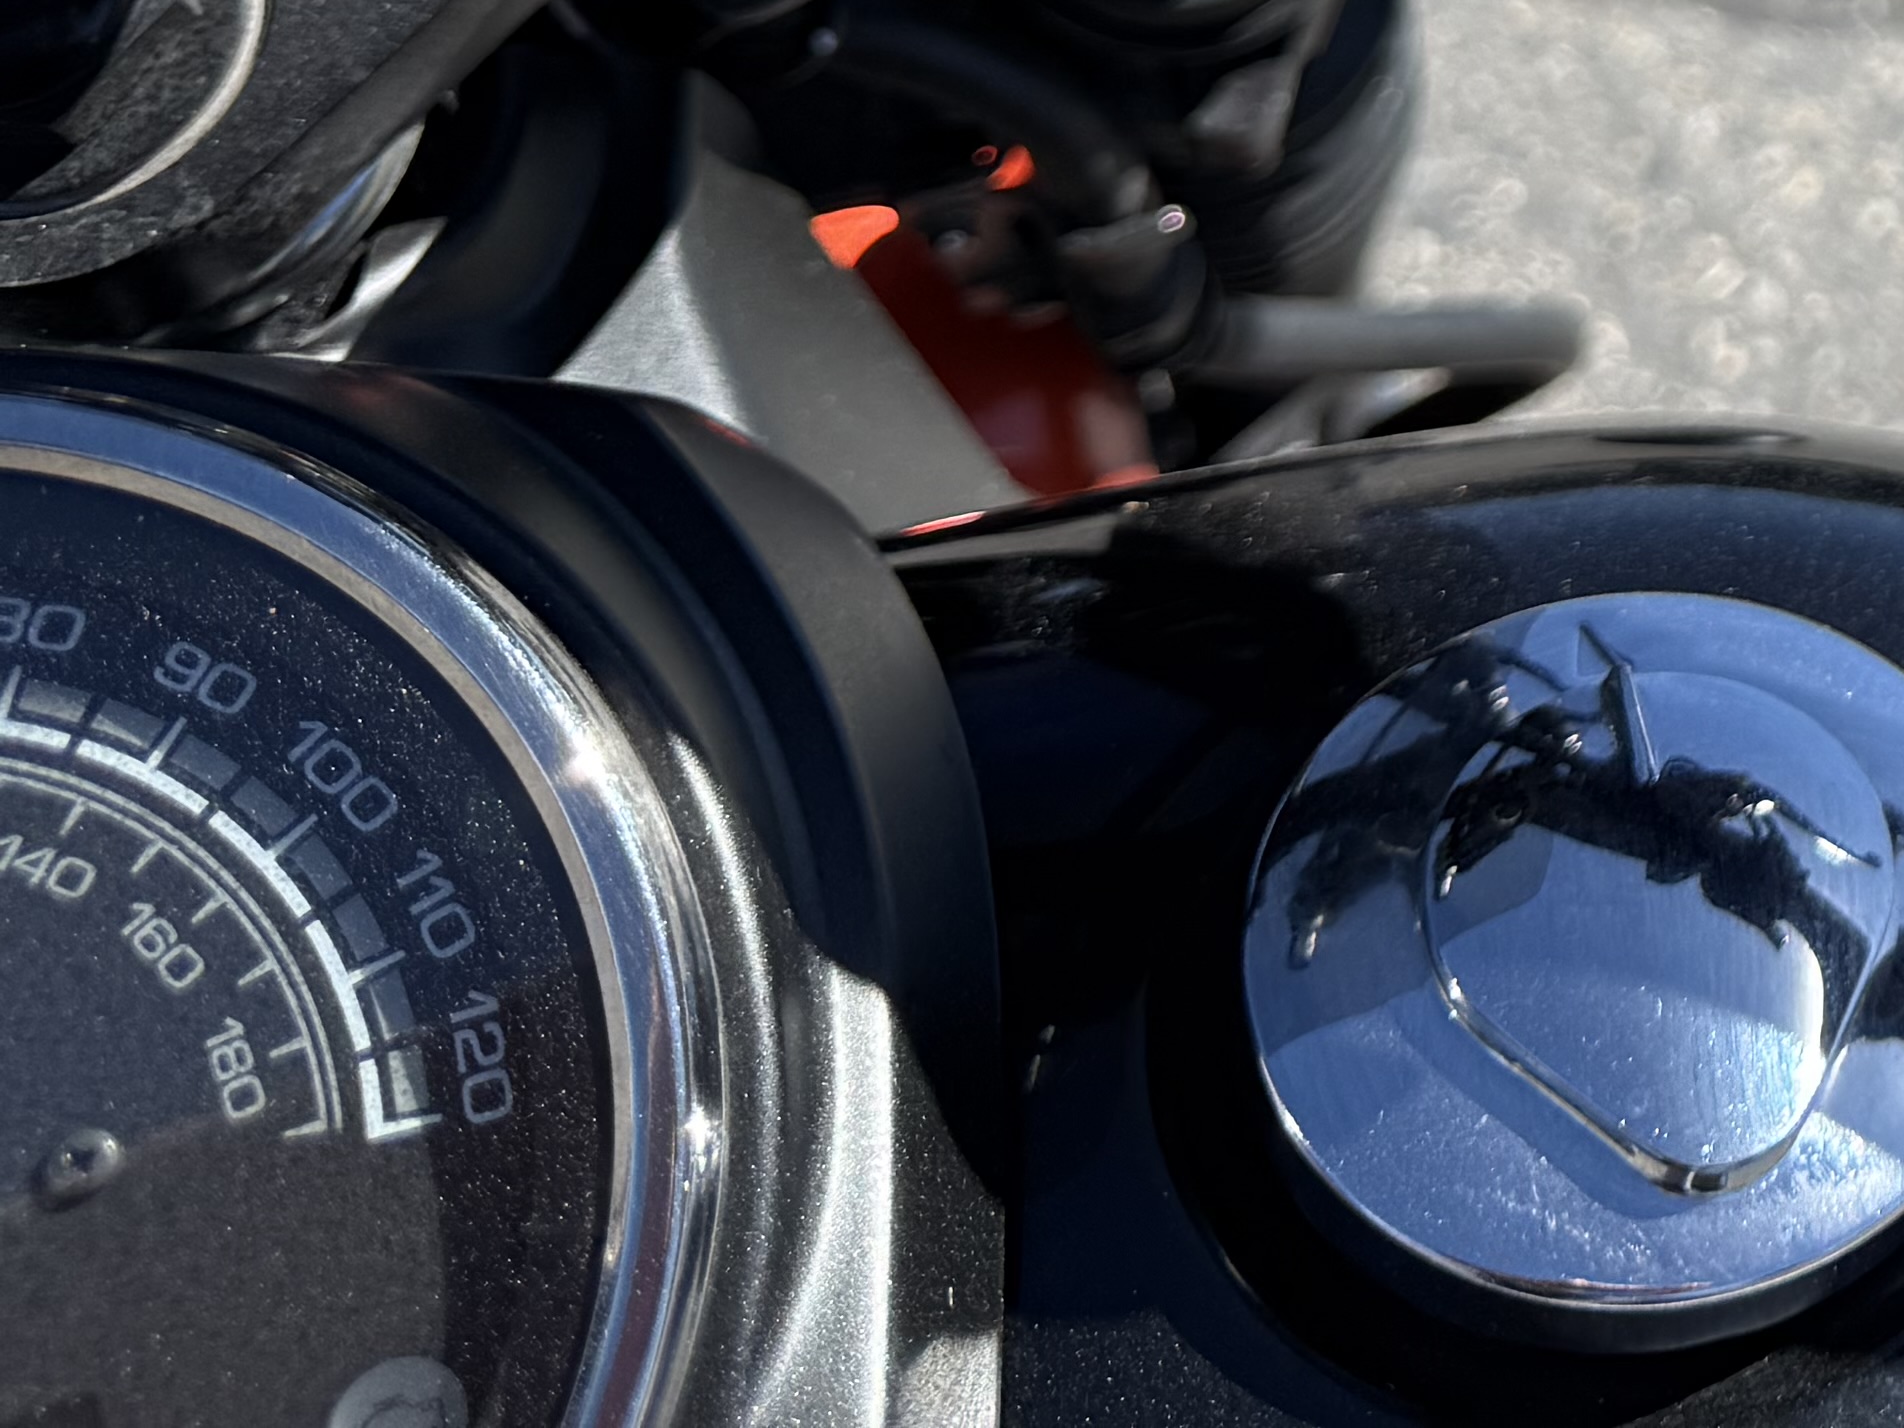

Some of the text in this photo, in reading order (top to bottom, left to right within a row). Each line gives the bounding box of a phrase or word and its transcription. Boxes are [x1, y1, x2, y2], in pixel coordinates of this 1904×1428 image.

[153, 641, 257, 715] 90
[286, 719, 399, 833] 100
[0, 834, 97, 899] 140
[396, 850, 477, 960] 110
[120, 901, 206, 991] 160
[205, 1016, 266, 1121] 180
[448, 989, 514, 1126] 120
